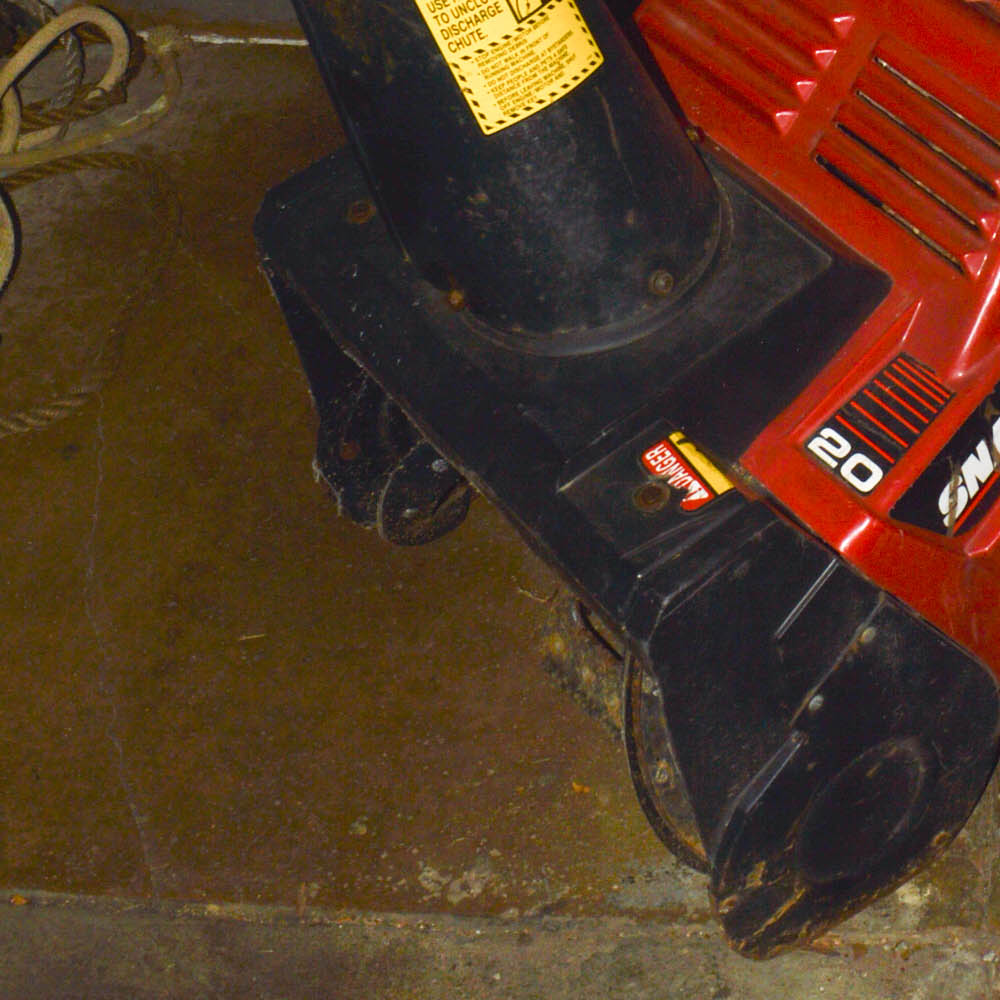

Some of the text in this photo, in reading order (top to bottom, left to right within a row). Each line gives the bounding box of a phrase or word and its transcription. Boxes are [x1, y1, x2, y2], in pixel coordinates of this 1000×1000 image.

[433, 11, 451, 27] TO
[440, 1, 503, 41] DISCHARGE
[645, 444, 693, 488] DANGER
[807, 427, 884, 494] 20
